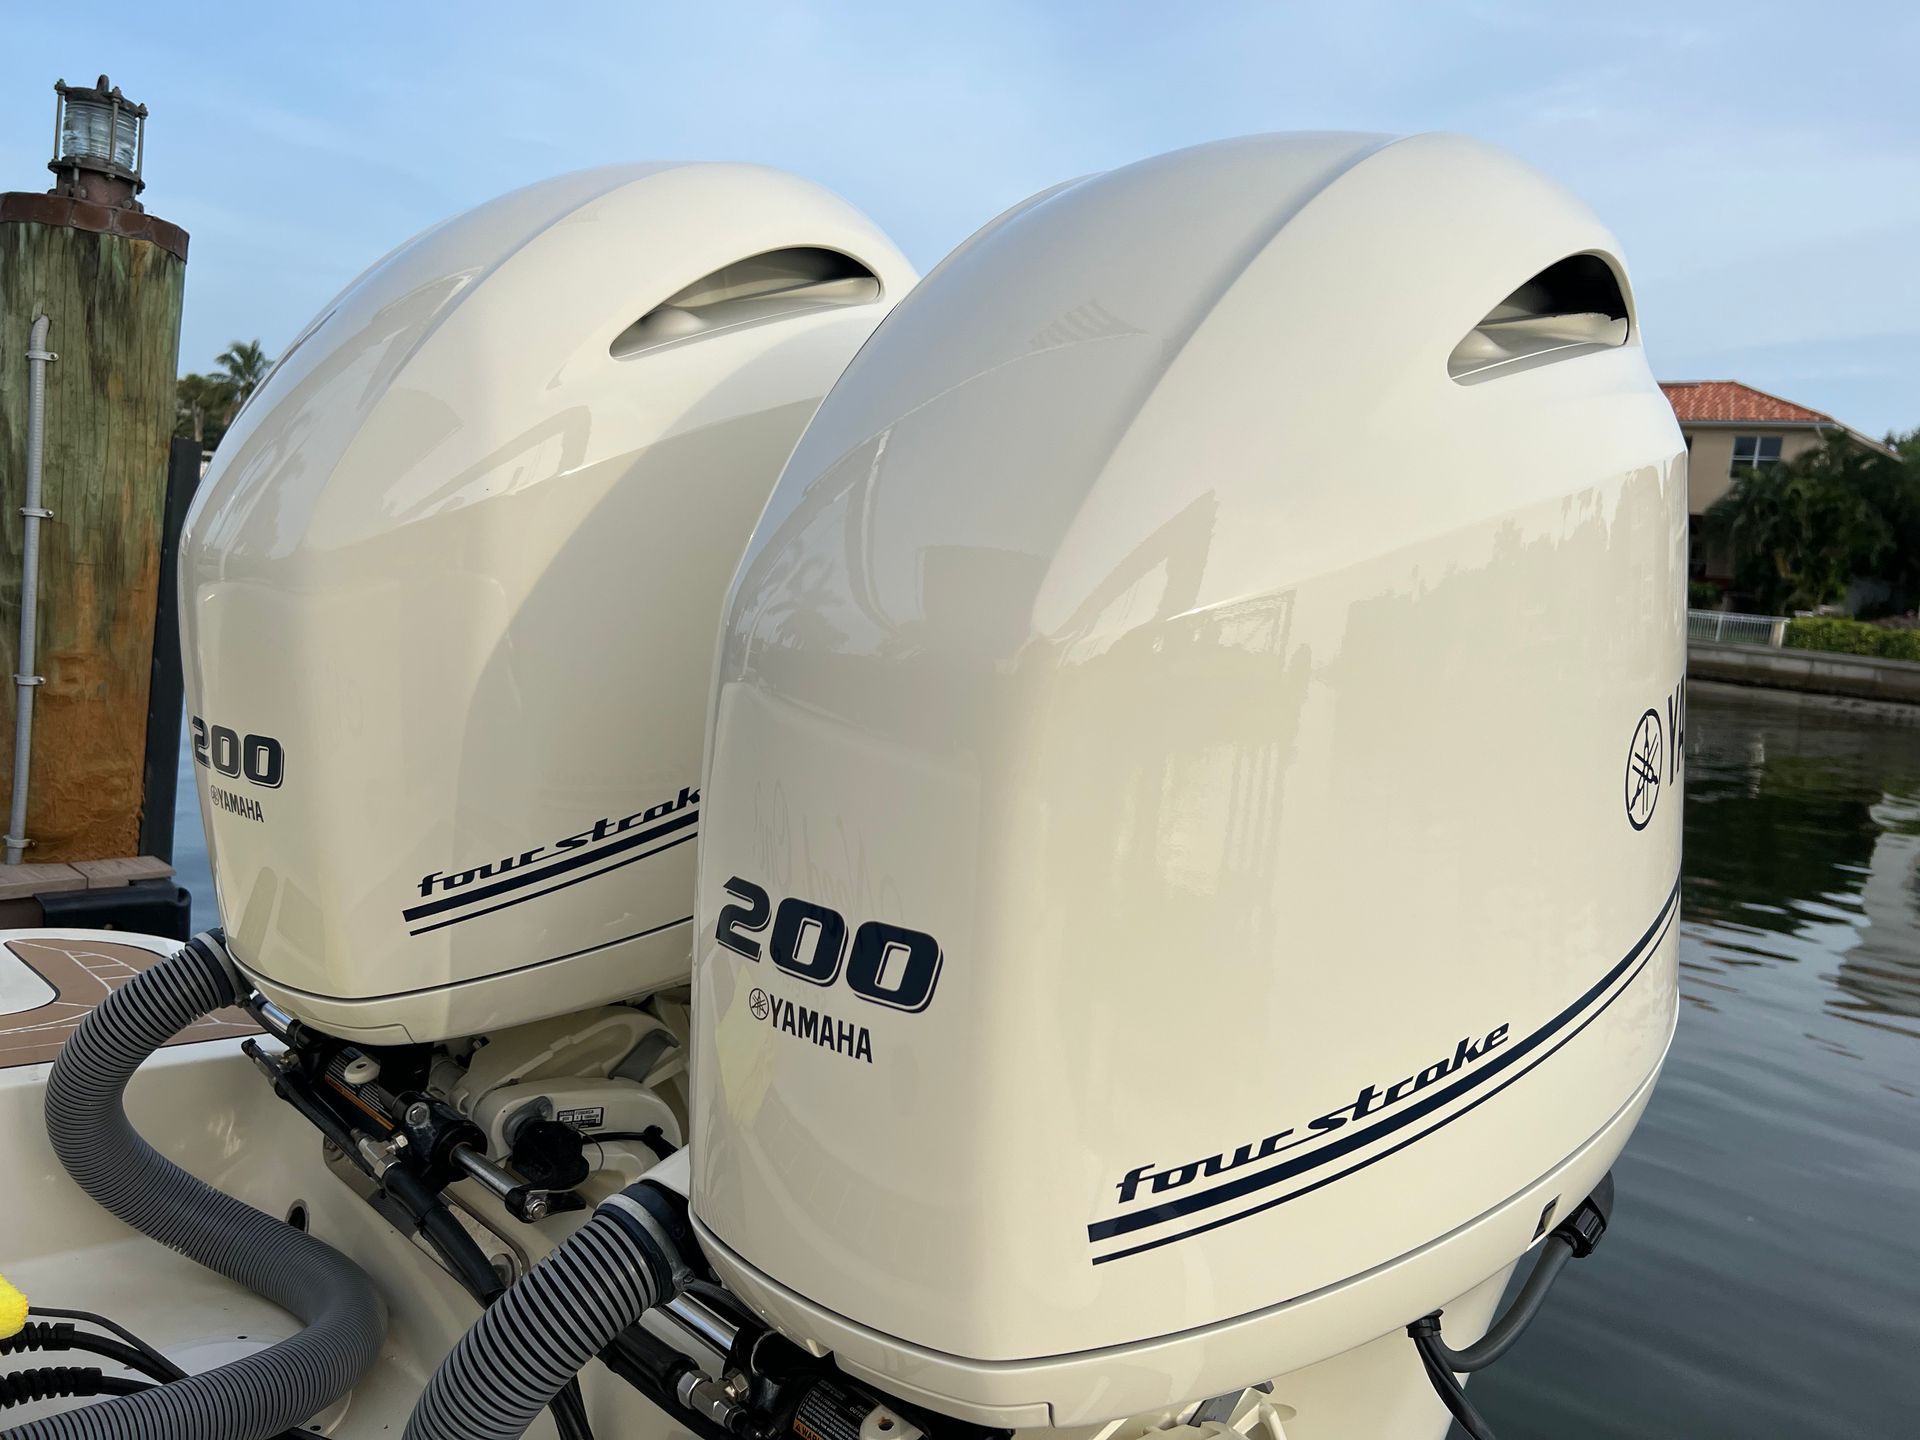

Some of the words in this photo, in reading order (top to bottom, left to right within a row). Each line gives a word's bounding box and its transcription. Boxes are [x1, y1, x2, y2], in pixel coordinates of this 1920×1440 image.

[192, 715, 285, 789] 200
[217, 787, 265, 823] YAMAHA
[417, 847, 547, 898] four
[555, 786, 701, 850] strok
[715, 875, 944, 1014] 200
[769, 993, 873, 1064] YAMAHA
[1116, 1127, 1295, 1204] four
[1307, 1022, 1510, 1132] stroke
